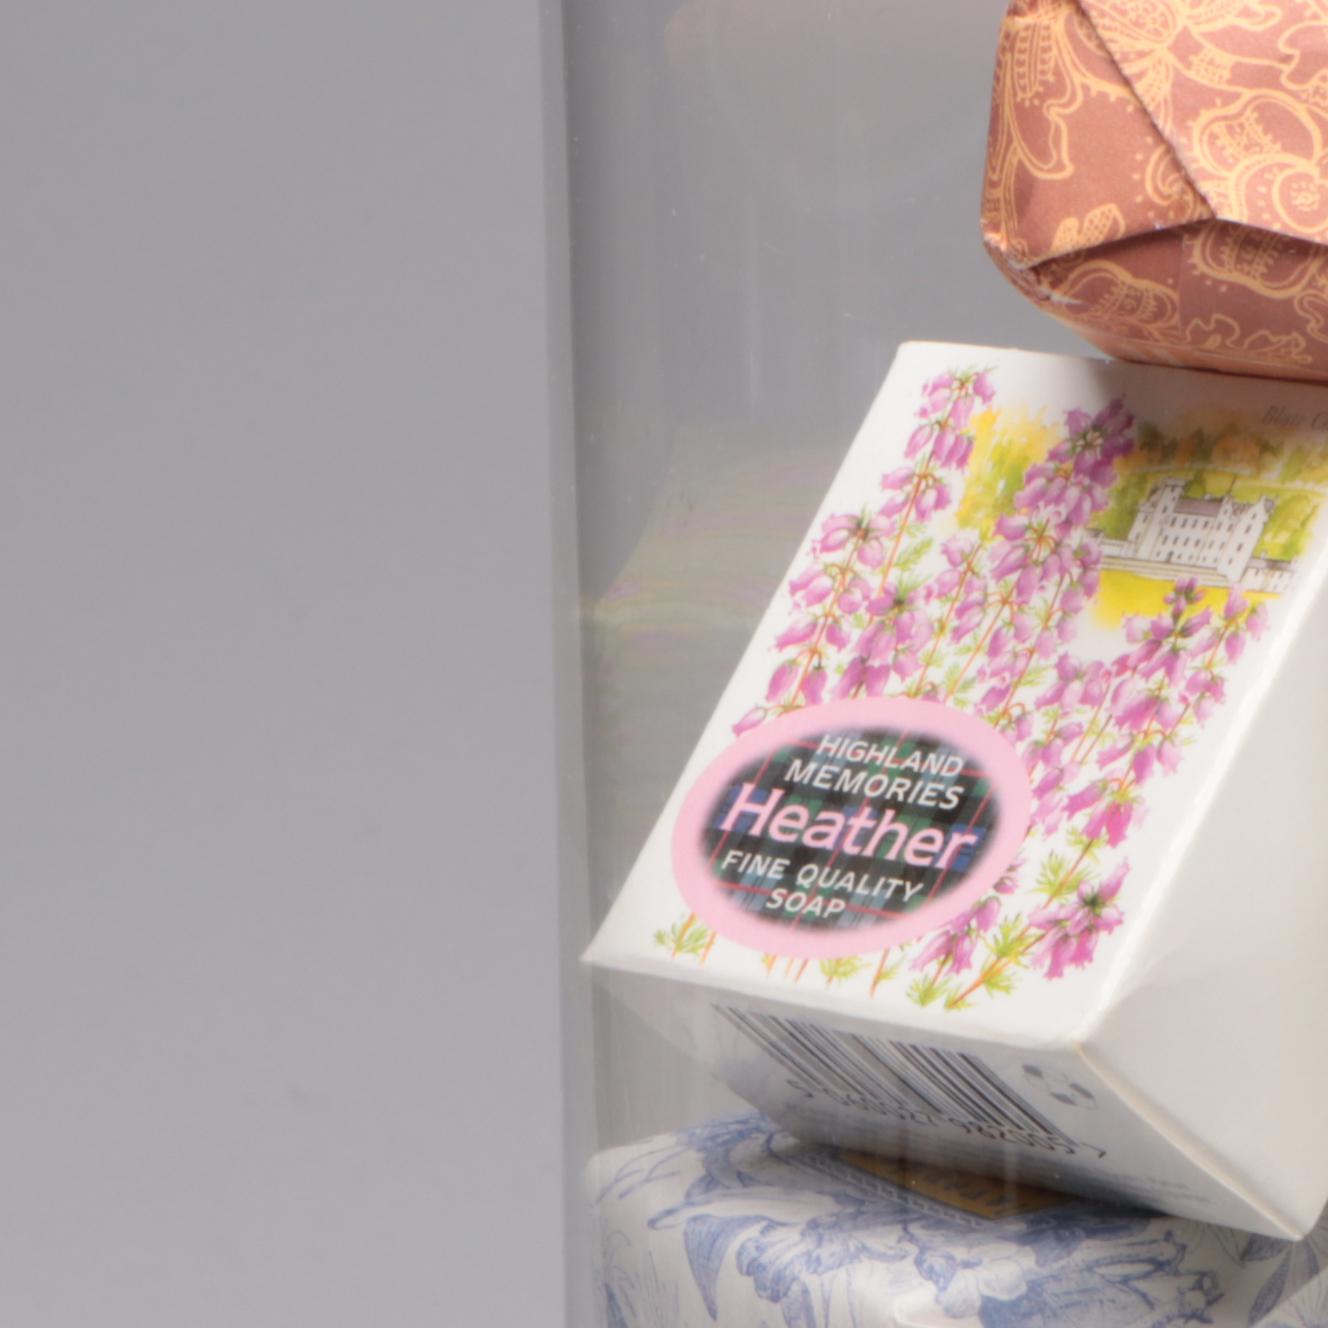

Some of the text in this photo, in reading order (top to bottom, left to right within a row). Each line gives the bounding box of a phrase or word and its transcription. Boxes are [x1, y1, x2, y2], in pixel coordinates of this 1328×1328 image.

[815, 734, 965, 778] HIGHLAND
[784, 759, 965, 810] MEMORIES
[719, 782, 980, 870] Heather
[721, 850, 924, 902] FINE QUALITY
[765, 888, 846, 918] SOAP
